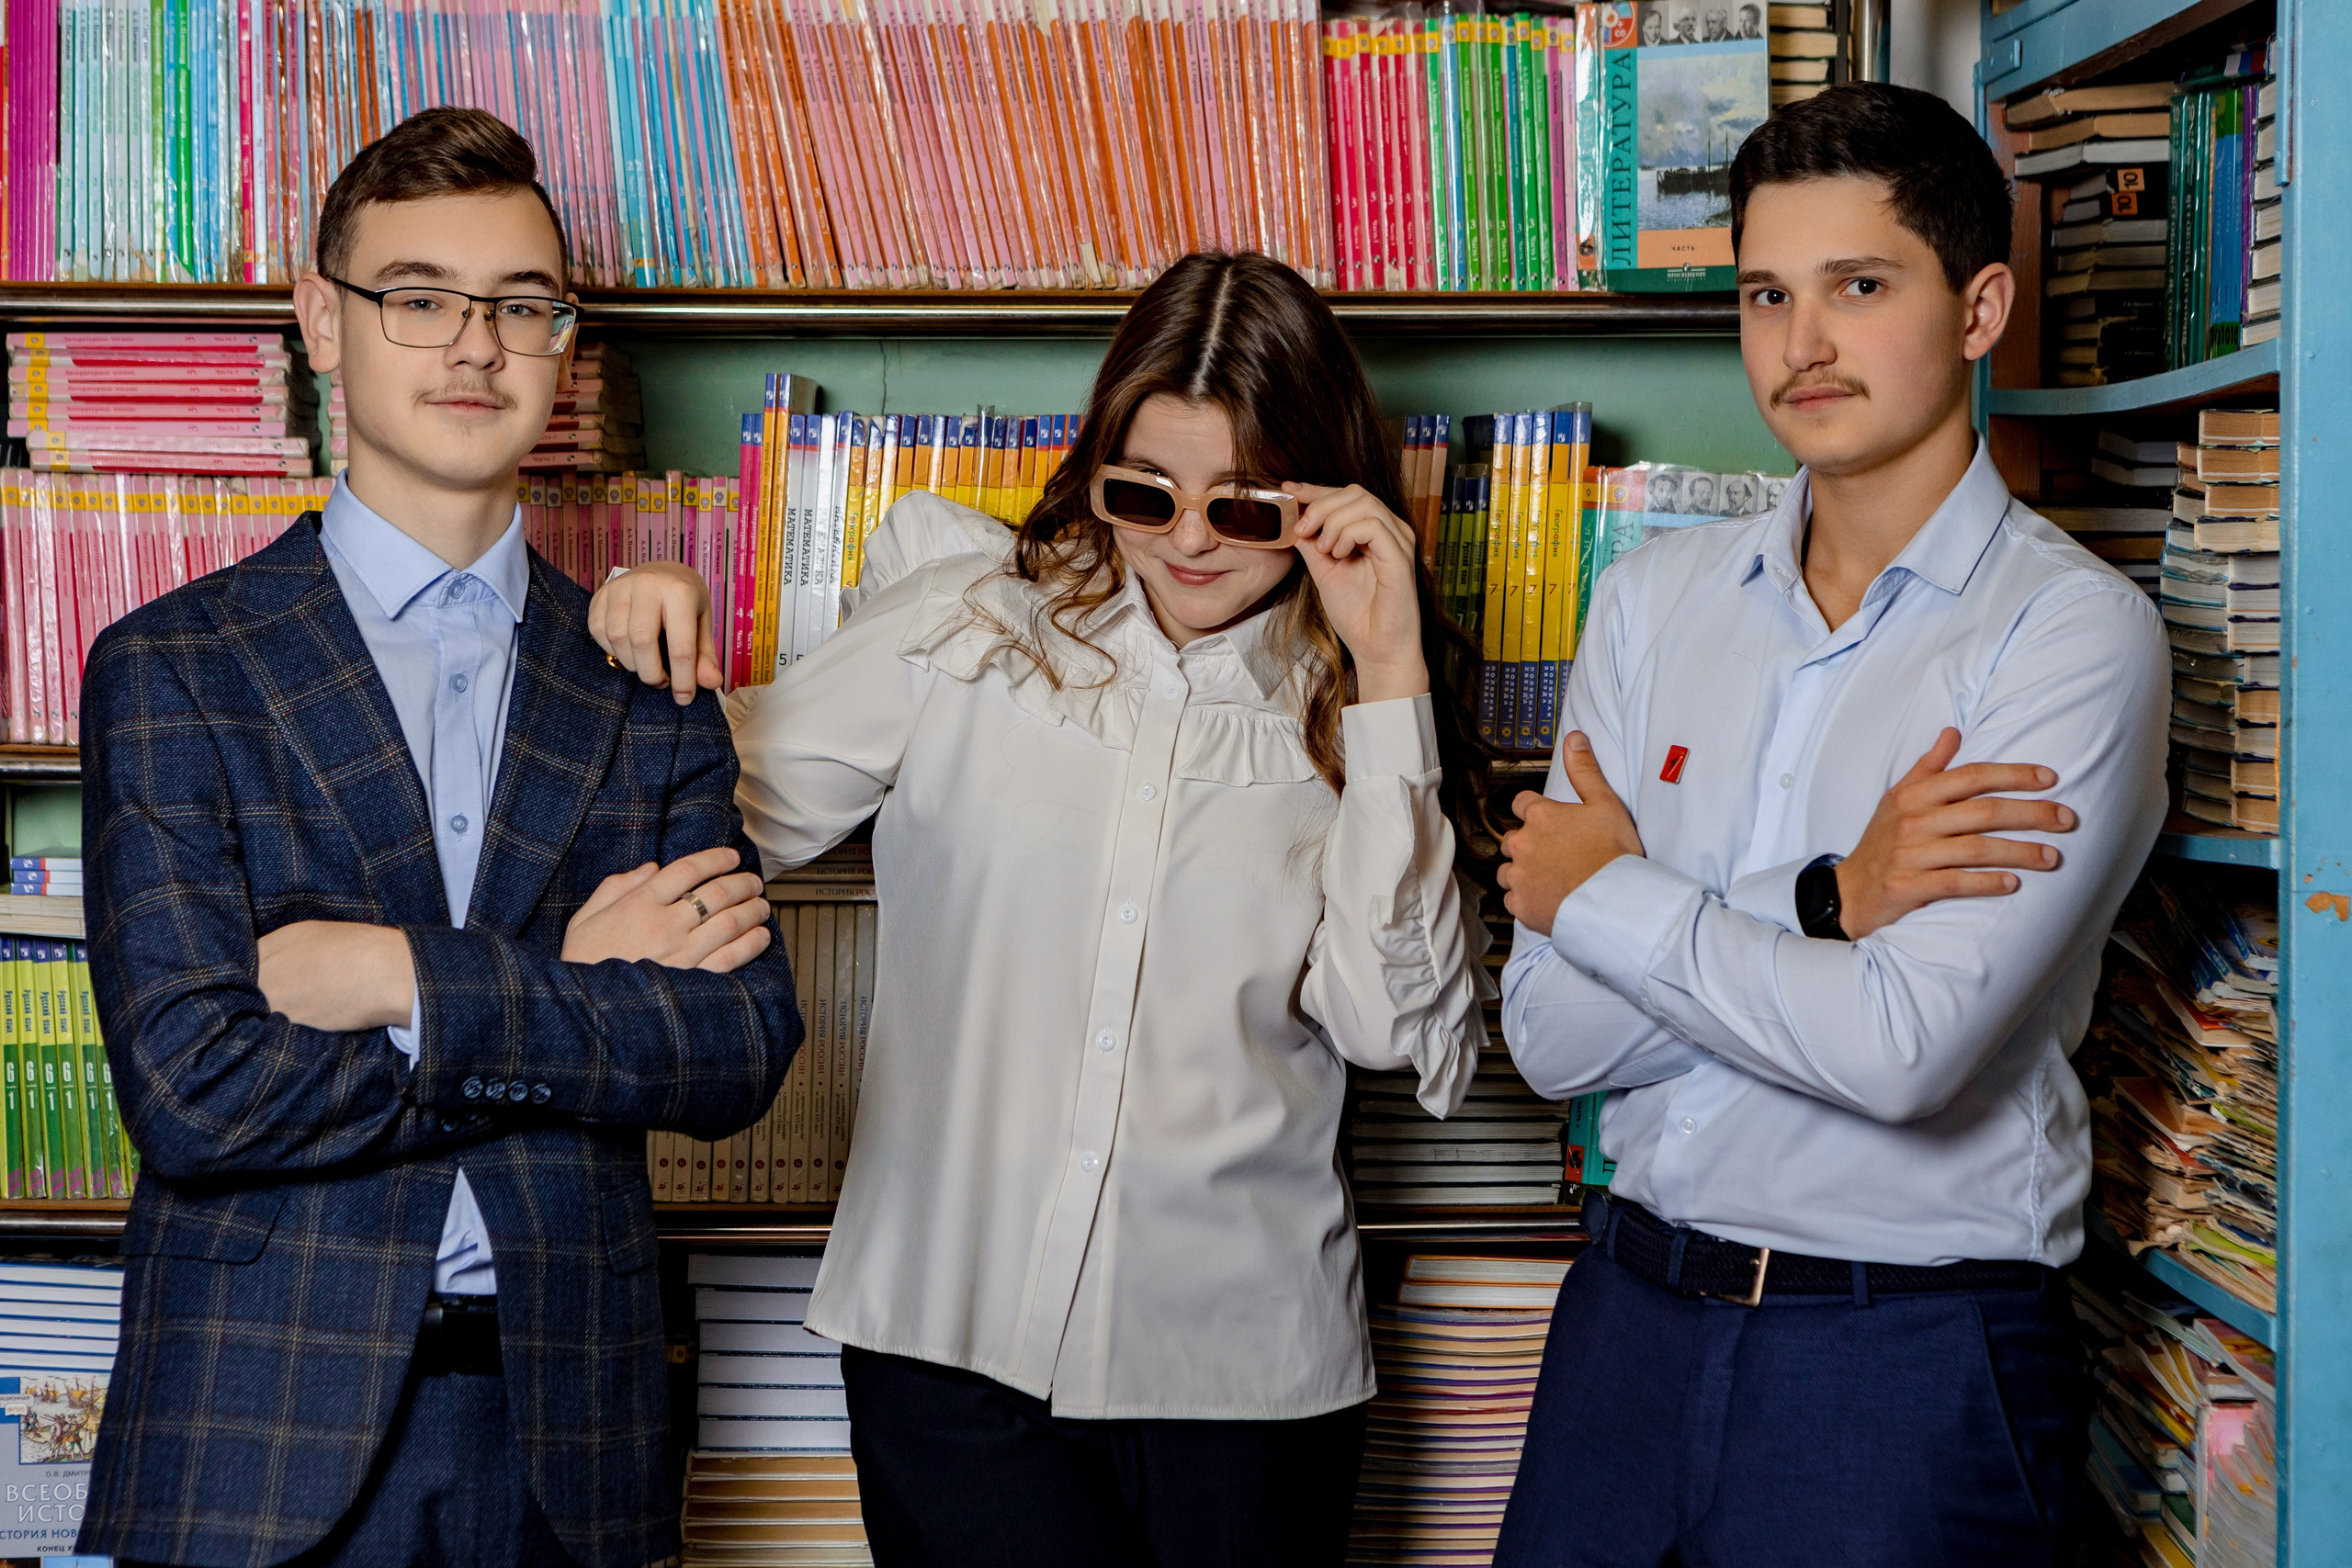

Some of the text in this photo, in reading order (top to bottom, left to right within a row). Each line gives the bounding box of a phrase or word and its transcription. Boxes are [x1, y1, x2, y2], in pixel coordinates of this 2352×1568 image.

[1614, 28, 1626, 38] CD
[1612, 51, 1631, 265] ЛИТЕРАТУРА
[2123, 172, 2138, 189] 10
[746, 186, 752, 197] 3
[1405, 192, 1411, 204] 3
[2117, 196, 2132, 212] 10
[1470, 220, 1476, 230] 3
[739, 506, 748, 551] Литературное
[751, 506, 759, 552] Литературное
[847, 513, 858, 561] География
[800, 508, 813, 586] МАТЕМАТИКА
[1462, 542, 1471, 566] Русский
[1489, 509, 1504, 595] География 7
[1510, 511, 1523, 596] География 7
[1549, 509, 1563, 595] География 7
[778, 508, 797, 666] МАТЕМАТИКА 5
[1568, 583, 1576, 594] 7
[736, 608, 743, 618] 4
[747, 608, 754, 619] 4
[817, 867, 855, 875] ИСТОРИЯ
[815, 888, 854, 897] ИСТОРИЯ
[4, 990, 14, 1016] Русский
[22, 989, 32, 1014] Русский
[40, 991, 51, 1016] Русский
[57, 990, 68, 1032] Русский язык
[80, 990, 91, 1033] Русский язык
[819, 998, 827, 1038] ИСТОРИЯ
[838, 1000, 847, 1077] ИСТОРИЯ РОССИИ
[858, 996, 867, 1071] ИСТОРИЯ РОССИИ
[6, 1062, 15, 1083] 6
[26, 1061, 35, 1082] 6
[44, 1063, 54, 1084] 6
[62, 1061, 72, 1082] 6
[85, 1062, 95, 1083] 6
[8, 1089, 15, 1111] 1
[28, 1090, 35, 1109] 1
[48, 1091, 55, 1111] 1
[65, 1090, 73, 1110] 1
[89, 1090, 96, 1111] 1
[106, 1091, 113, 1111] 1
[1569, 1150, 1582, 1169] 6
